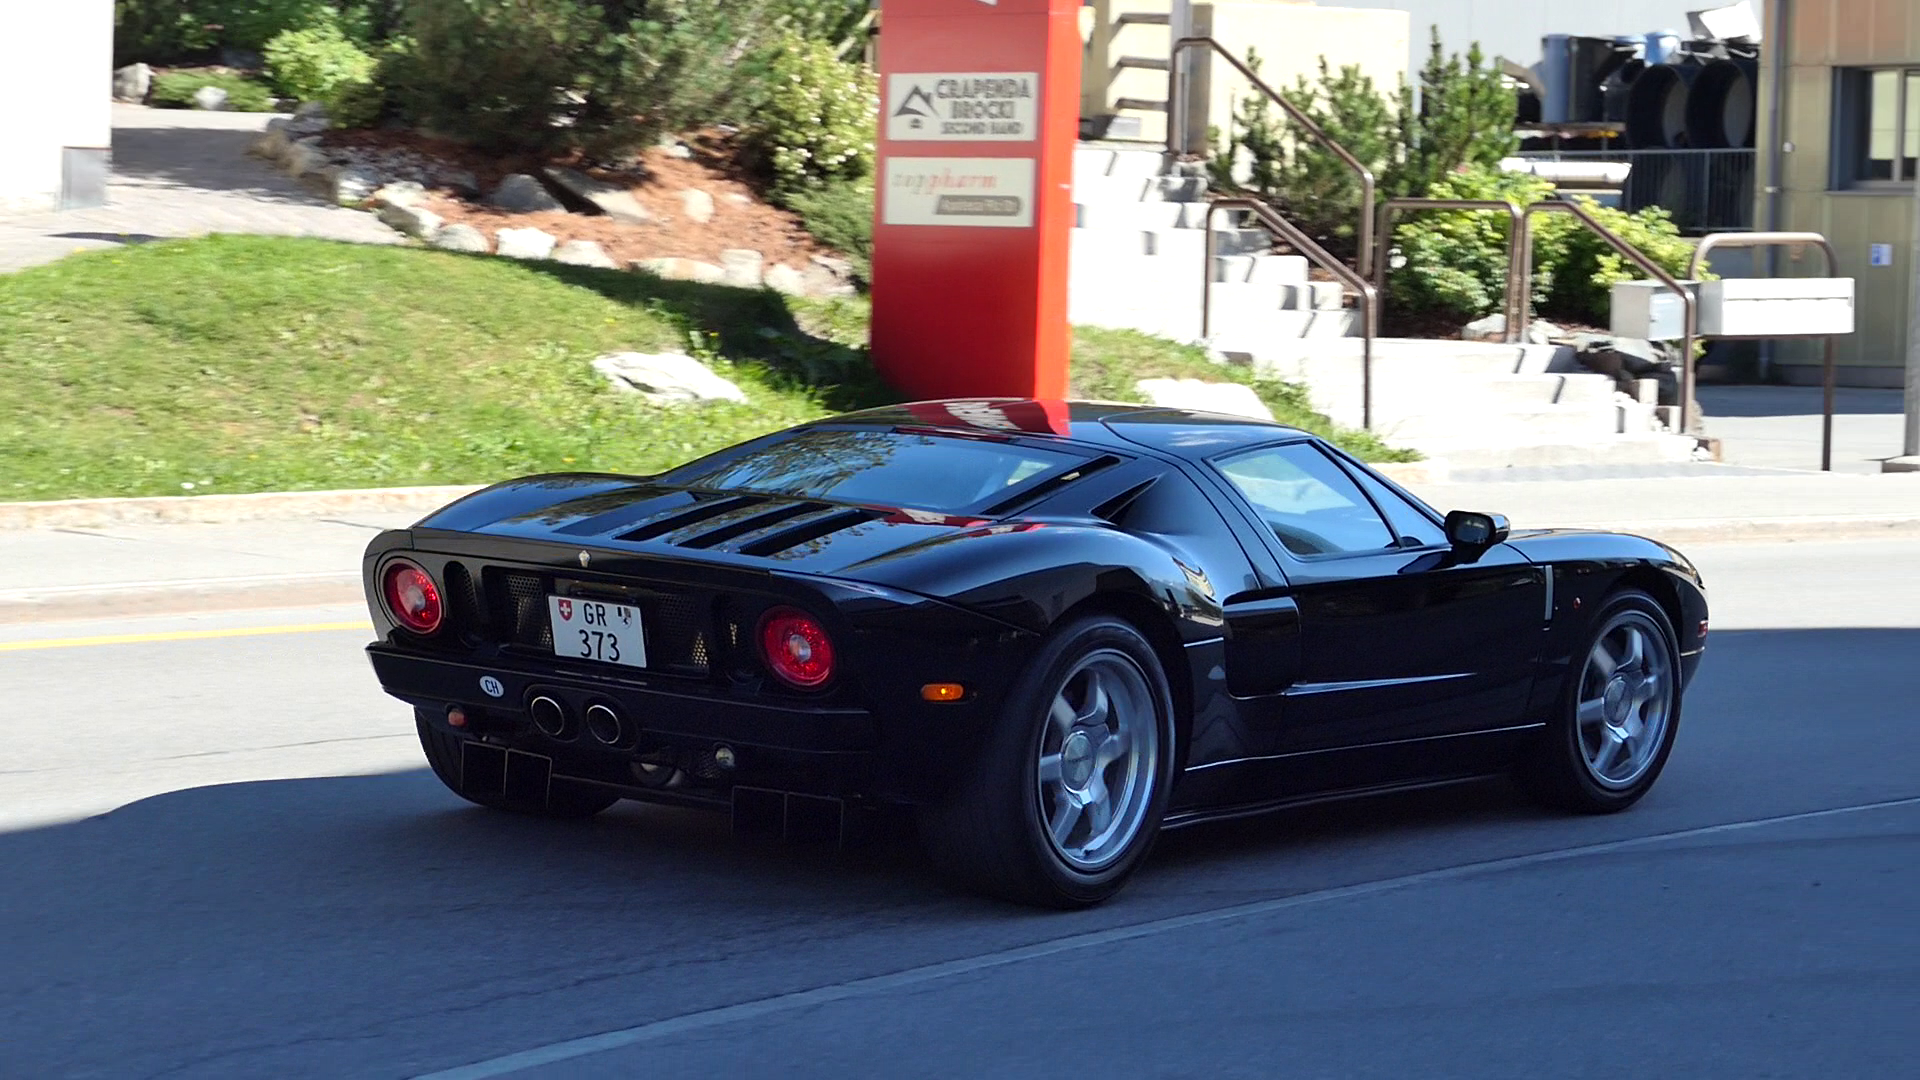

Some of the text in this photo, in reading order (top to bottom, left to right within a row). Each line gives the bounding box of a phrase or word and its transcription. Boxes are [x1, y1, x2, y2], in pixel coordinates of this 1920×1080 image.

[583, 602, 607, 627] GR
[579, 629, 620, 661] 373
[484, 679, 500, 695] CH
